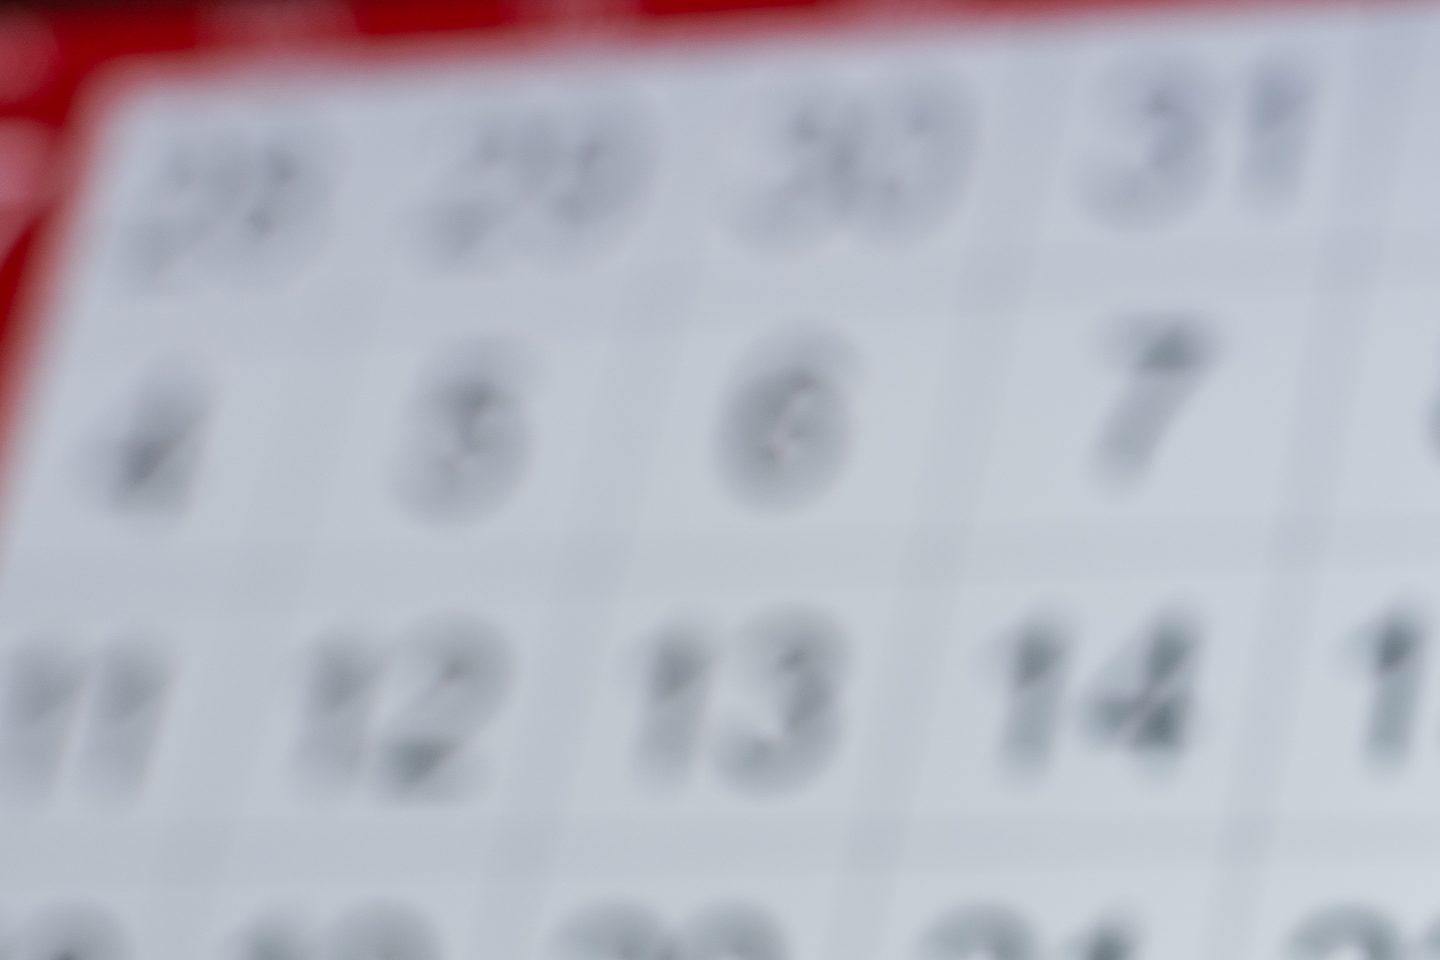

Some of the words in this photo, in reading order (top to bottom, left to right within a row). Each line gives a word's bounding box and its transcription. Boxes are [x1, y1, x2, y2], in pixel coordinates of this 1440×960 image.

[1072, 50, 1318, 228] 31
[392, 334, 542, 526] 5
[712, 316, 864, 516] 6
[1090, 306, 1222, 496] 7
[0, 638, 180, 806] 11
[292, 608, 517, 806] 12
[630, 602, 852, 796] 13
[986, 604, 1203, 784] 14
